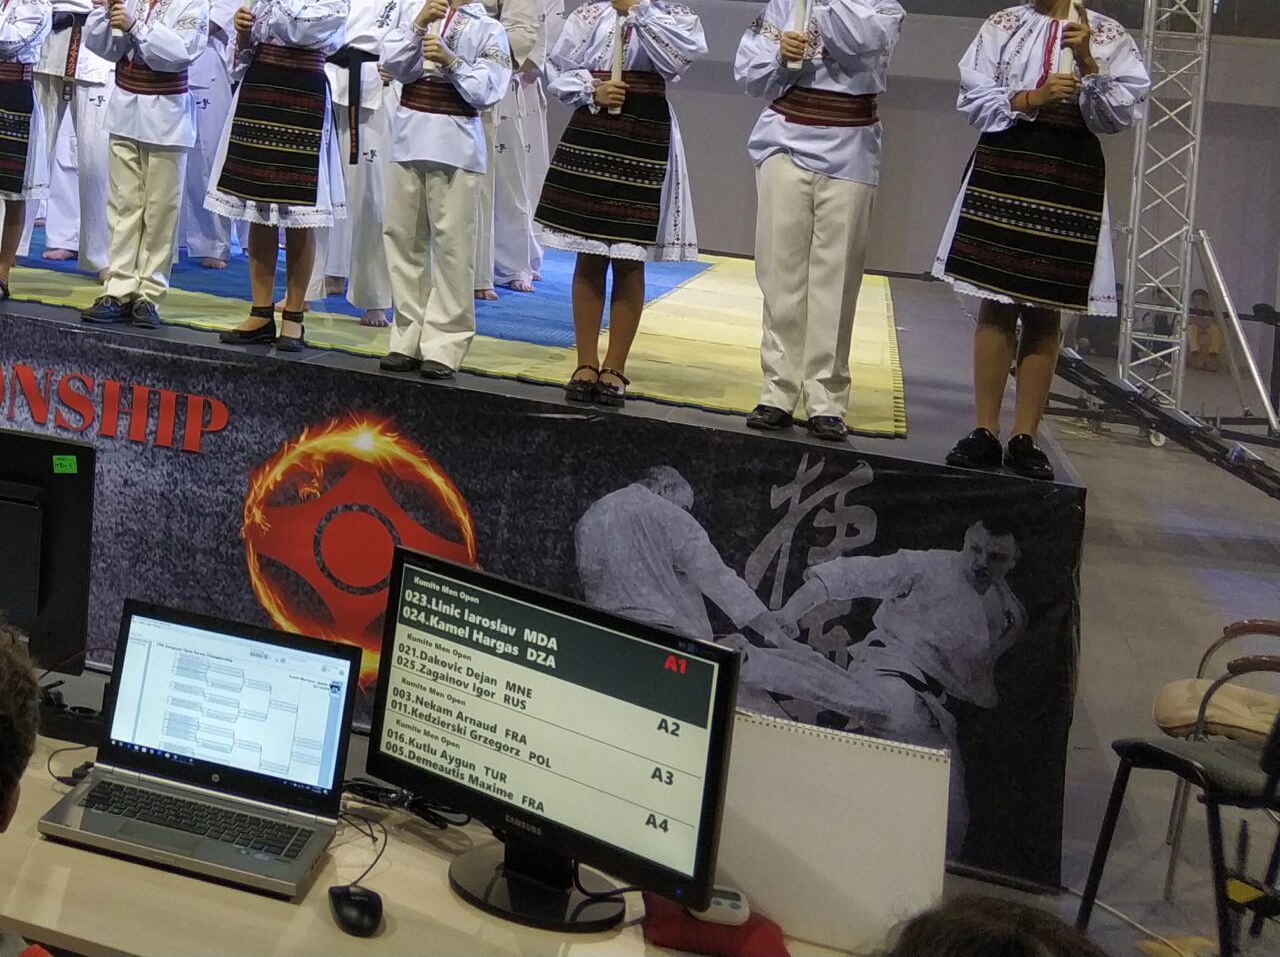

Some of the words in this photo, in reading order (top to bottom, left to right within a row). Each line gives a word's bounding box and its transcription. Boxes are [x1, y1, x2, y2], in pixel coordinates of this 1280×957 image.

[414, 576, 440, 591] Kumite
[441, 585, 458, 597] Men
[460, 591, 479, 604] Open
[402, 606, 470, 639] 024.Kamel
[473, 629, 519, 656] Hargas
[527, 648, 556, 669] DZA
[404, 589, 461, 618] 023.Linic
[523, 629, 558, 651] MDA
[407, 633, 433, 648] Kumite
[435, 642, 451, 654] Men
[453, 649, 472, 661] Open
[663, 655, 688, 675] A1
[396, 655, 470, 691] 025.Zagainov
[472, 683, 496, 699] Igor
[503, 693, 527, 710] RUS
[398, 643, 463, 674] 021.Dakovic
[466, 666, 498, 687] Dejan
[505, 680, 533, 699] MNE
[401, 676, 427, 692] Kumite
[428, 687, 445, 699] Men
[447, 693, 466, 706] Open
[391, 699, 467, 736] 011.Kedzierski
[470, 729, 521, 757] Grzegorz
[528, 751, 552, 769] POL
[392, 686, 453, 717] 003.Nekam
[456, 711, 498, 734] Arnaud
[504, 728, 528, 746] FRA
[395, 718, 422, 734] Kumite
[423, 729, 440, 741] Men
[441, 736, 461, 749] Open
[656, 718, 680, 737] A2
[385, 741, 465, 781] 005.Demeautis
[468, 773, 514, 801] Maxime
[521, 795, 545, 813] FRA
[387, 728, 437, 757] 016.Kutlu
[440, 750, 476, 773] Aygun
[484, 765, 508, 784] TUR
[651, 766, 675, 786] A3
[645, 813, 669, 833] A4
